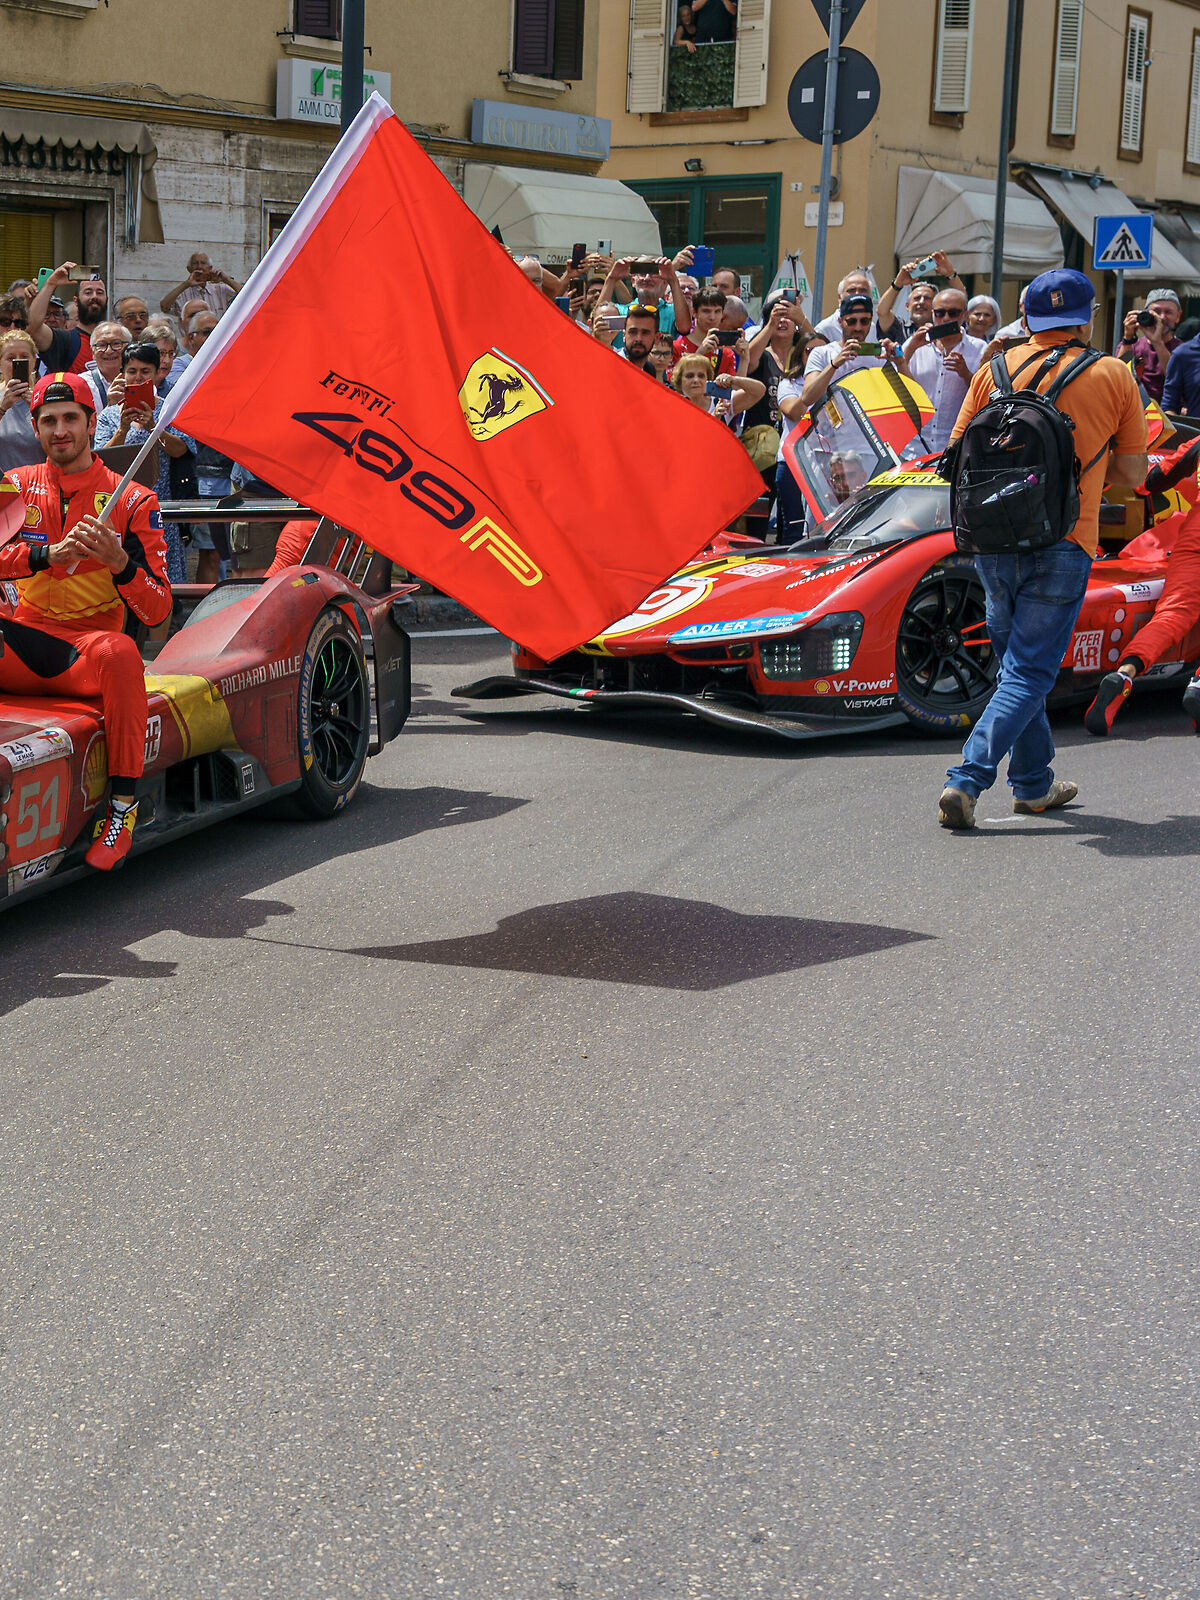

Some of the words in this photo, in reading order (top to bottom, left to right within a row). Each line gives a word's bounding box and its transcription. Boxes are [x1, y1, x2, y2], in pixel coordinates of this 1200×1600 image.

[318, 370, 397, 418] Ferrari
[681, 620, 748, 637] ADLER
[1074, 632, 1101, 647] YPER
[1074, 646, 1099, 667] AR
[220, 665, 267, 697] RICHARD
[269, 655, 300, 680] MILLE
[832, 678, 893, 693] V-Power
[15, 775, 62, 849] 51
[23, 855, 51, 880] WEC
